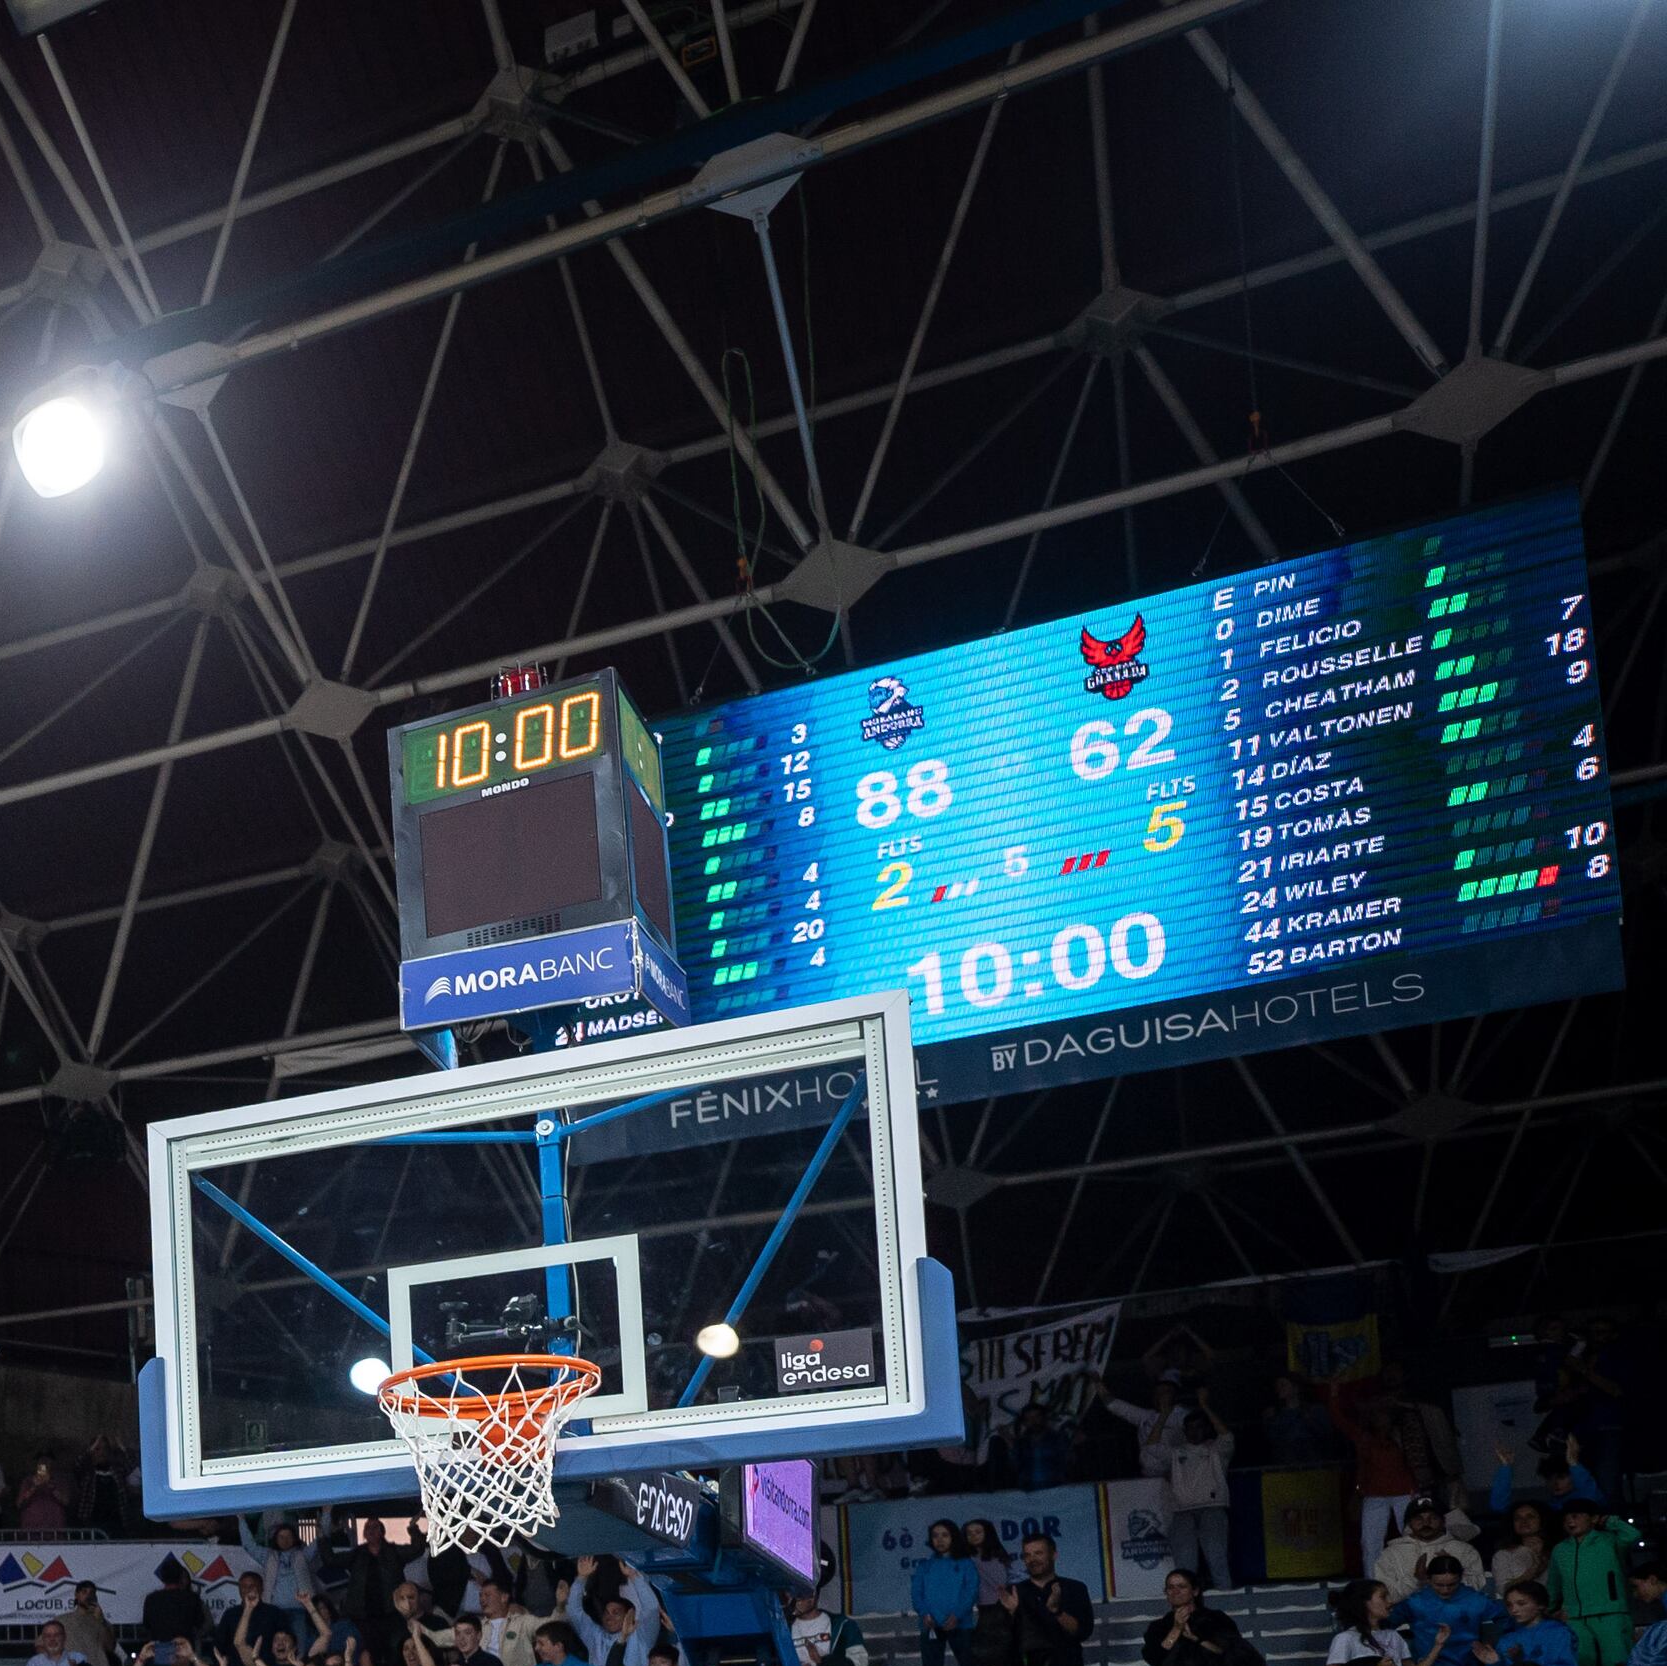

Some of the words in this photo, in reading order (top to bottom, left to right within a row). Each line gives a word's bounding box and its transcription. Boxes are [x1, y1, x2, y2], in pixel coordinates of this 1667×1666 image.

[1213, 587, 1235, 612] E
[1253, 573, 1296, 598] PIN
[1215, 618, 1235, 642] 0
[1256, 597, 1321, 629] DIME
[1219, 648, 1234, 671] 1
[1259, 619, 1363, 659] FELICIO
[1561, 594, 1585, 621] 7
[1219, 678, 1240, 702] 2
[1261, 634, 1424, 690] ROUSSELLE
[1544, 626, 1587, 656] 18
[1222, 707, 1243, 732] 5
[1264, 668, 1417, 721] CHEATHAM
[1565, 658, 1590, 686] 9
[435, 691, 601, 789] 10:00
[790, 723, 808, 744] 3
[1069, 706, 1178, 782] 62
[1228, 734, 1261, 762] 11
[1267, 701, 1415, 751] VALTONEN
[780, 752, 810, 775] 12
[1231, 766, 1267, 792] 14
[1571, 722, 1596, 748] 4
[480, 777, 530, 798] MONDO
[782, 779, 812, 803] 15
[855, 758, 955, 831] 88
[1146, 774, 1197, 802] FLTS
[1235, 795, 1269, 822] 15
[1273, 776, 1365, 811] COSTA
[1575, 754, 1601, 782] 6
[798, 806, 815, 828] 8
[1237, 825, 1274, 853] 19
[871, 861, 914, 912] 2
[1002, 844, 1030, 878] 5
[1142, 800, 1188, 853] 5
[877, 835, 924, 861] FLTS
[1237, 856, 1272, 884] 21
[1279, 834, 1386, 873] IRIARTE
[1563, 820, 1608, 851] 10
[802, 862, 820, 883] 4
[1239, 886, 1278, 916] 24
[1283, 869, 1368, 904] WILEY
[804, 890, 822, 911] 4
[1243, 914, 1281, 945] 44
[1285, 896, 1403, 935] KRAMER
[792, 918, 825, 944] 20
[1246, 946, 1285, 976] 52
[1288, 927, 1404, 967] BARTON
[454, 946, 614, 997] MORABANC
[809, 946, 826, 968] 4
[906, 911, 1167, 1017] 10:00
[992, 1045, 1017, 1073] BY
[780, 1350, 822, 1376] liga
[781, 1361, 871, 1387] endesa
